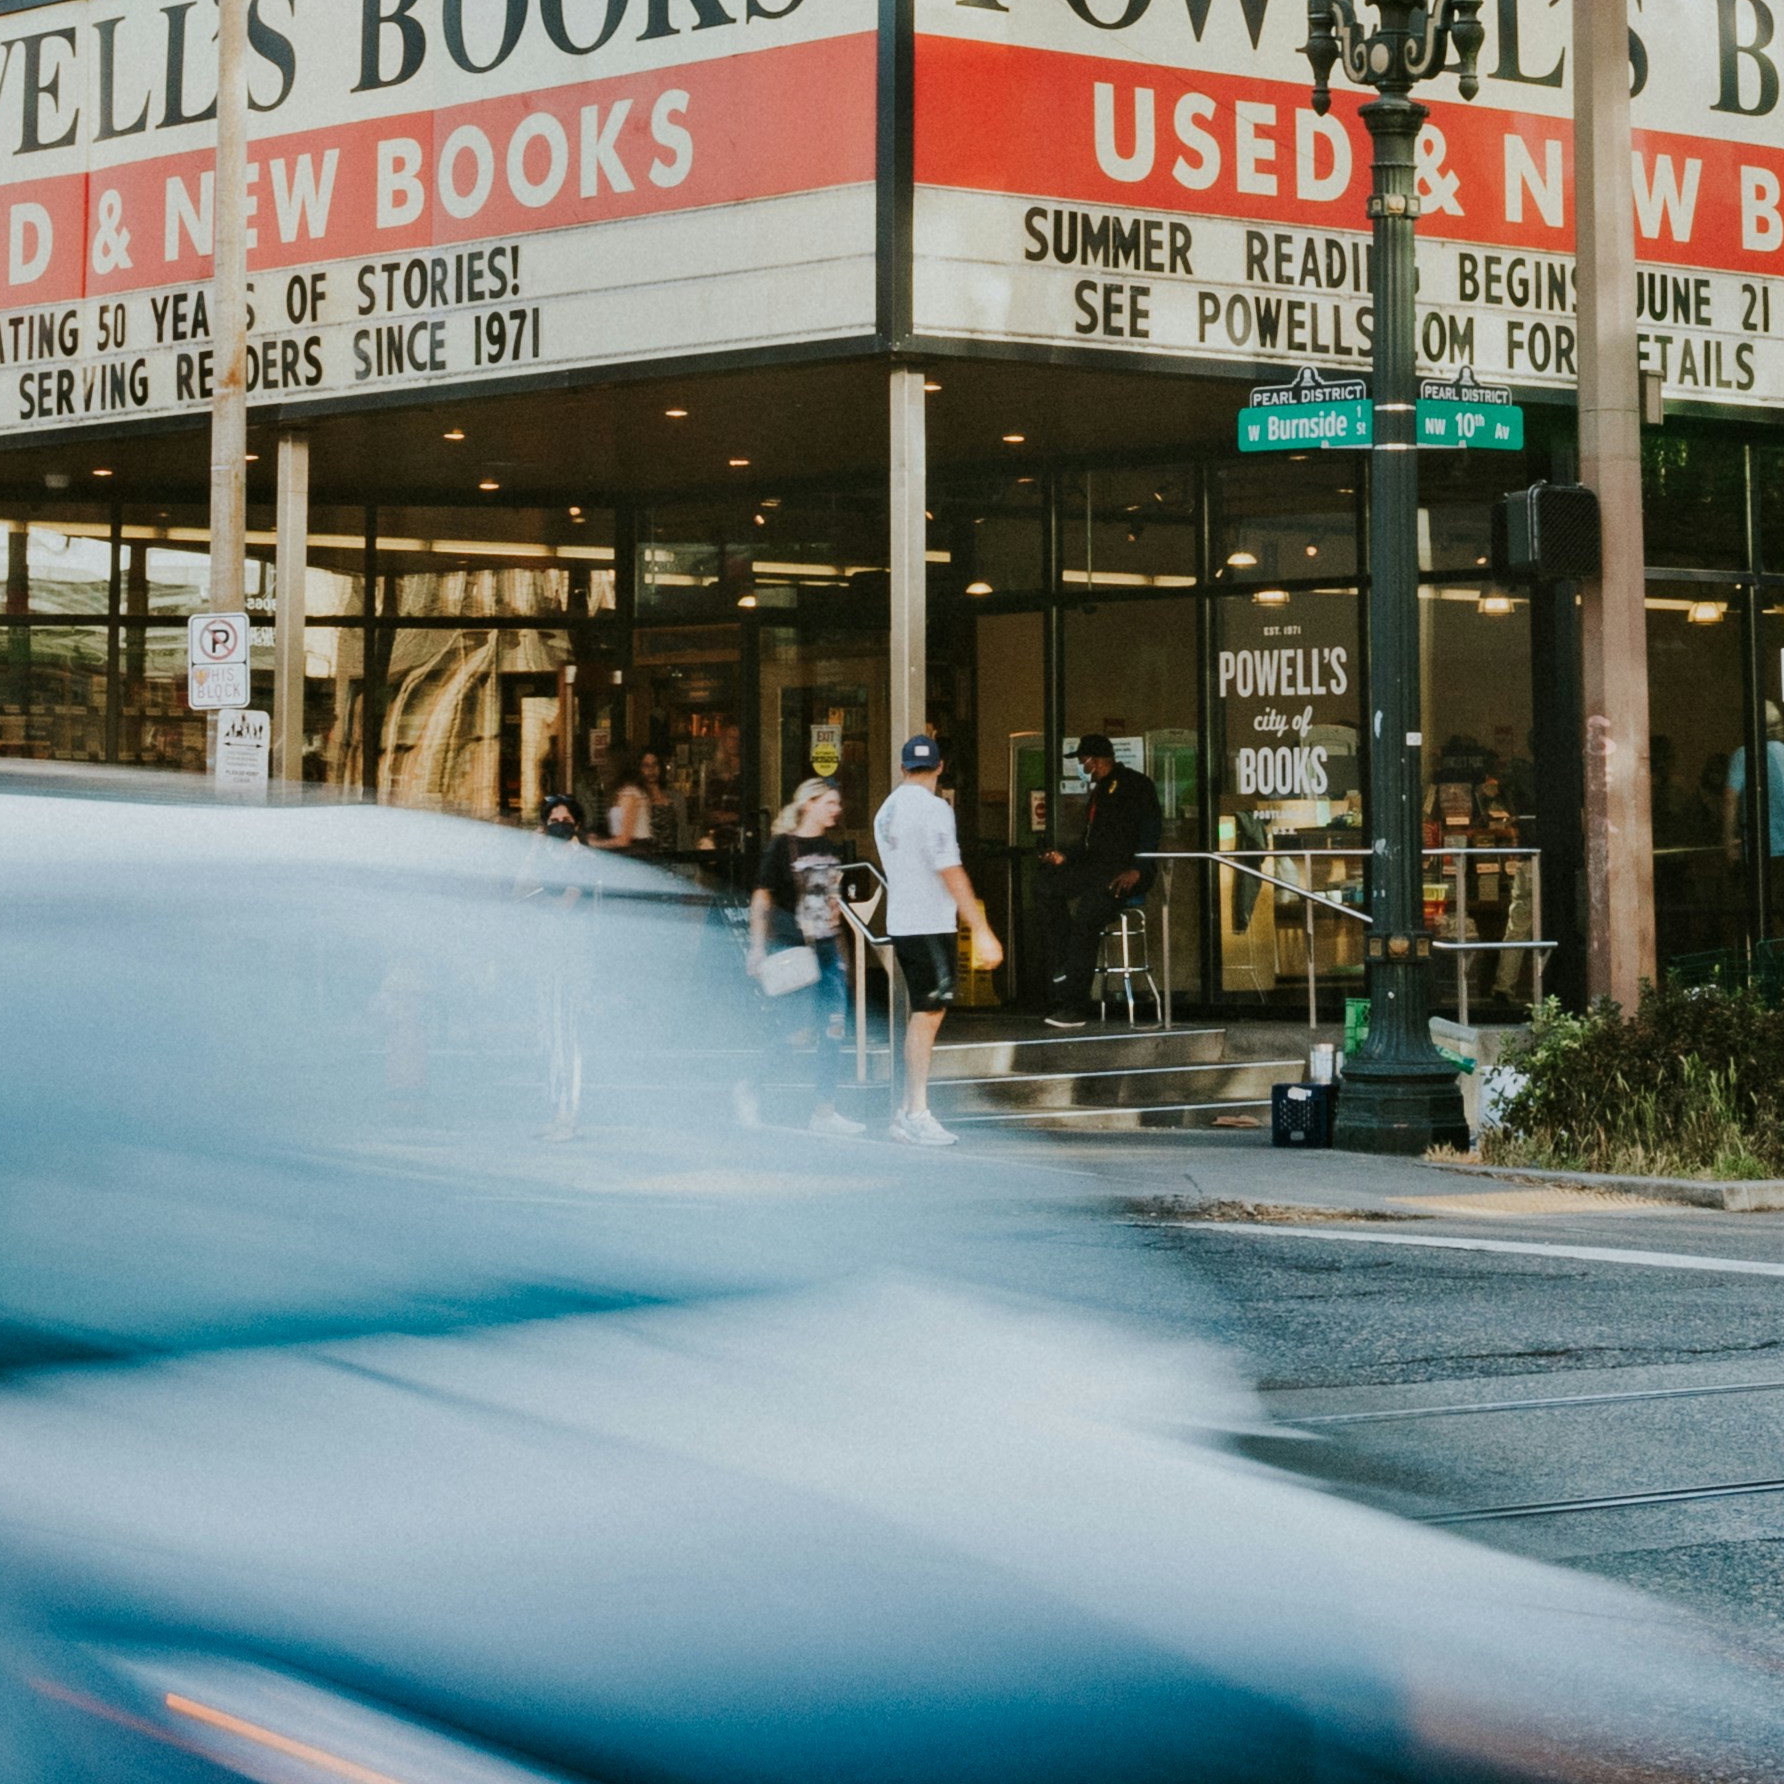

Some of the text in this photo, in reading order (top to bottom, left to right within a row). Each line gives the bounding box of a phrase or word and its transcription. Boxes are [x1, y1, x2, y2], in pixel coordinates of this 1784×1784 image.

[1093, 81, 1353, 202] USED
[1415, 122, 1466, 217] &
[1503, 133, 1703, 244] NW
[91, 188, 134, 275] &
[375, 88, 695, 230] BOOKS
[1023, 206, 1193, 276] SUMMER
[1741, 283, 1771, 333] 21
[96, 302, 126, 352] 50
[150, 282, 256, 344] YEA
[286, 272, 327, 325] OF
[357, 244, 520, 316] STORIES!
[1074, 279, 1755, 392] SEE POWELLSOM FOR ETAILS
[19, 306, 540, 421] SERVING REDERS SINCE 1971
[1252, 384, 1363, 407] PEARL DISTRICT
[1423, 384, 1509, 405] PEARL DISTRICT
[1247, 410, 1367, 442] W Burnside St
[1424, 412, 1510, 441] NW 10th Av
[1263, 625, 1302, 636] EST. 1971
[204, 667, 235, 683] HIS
[1218, 645, 1348, 698] POWELL'S
[197, 683, 241, 700] BLOCK
[816, 730, 835, 743] EXIT
[1253, 705, 1313, 738] city of
[1238, 745, 1328, 796] BOOKS
